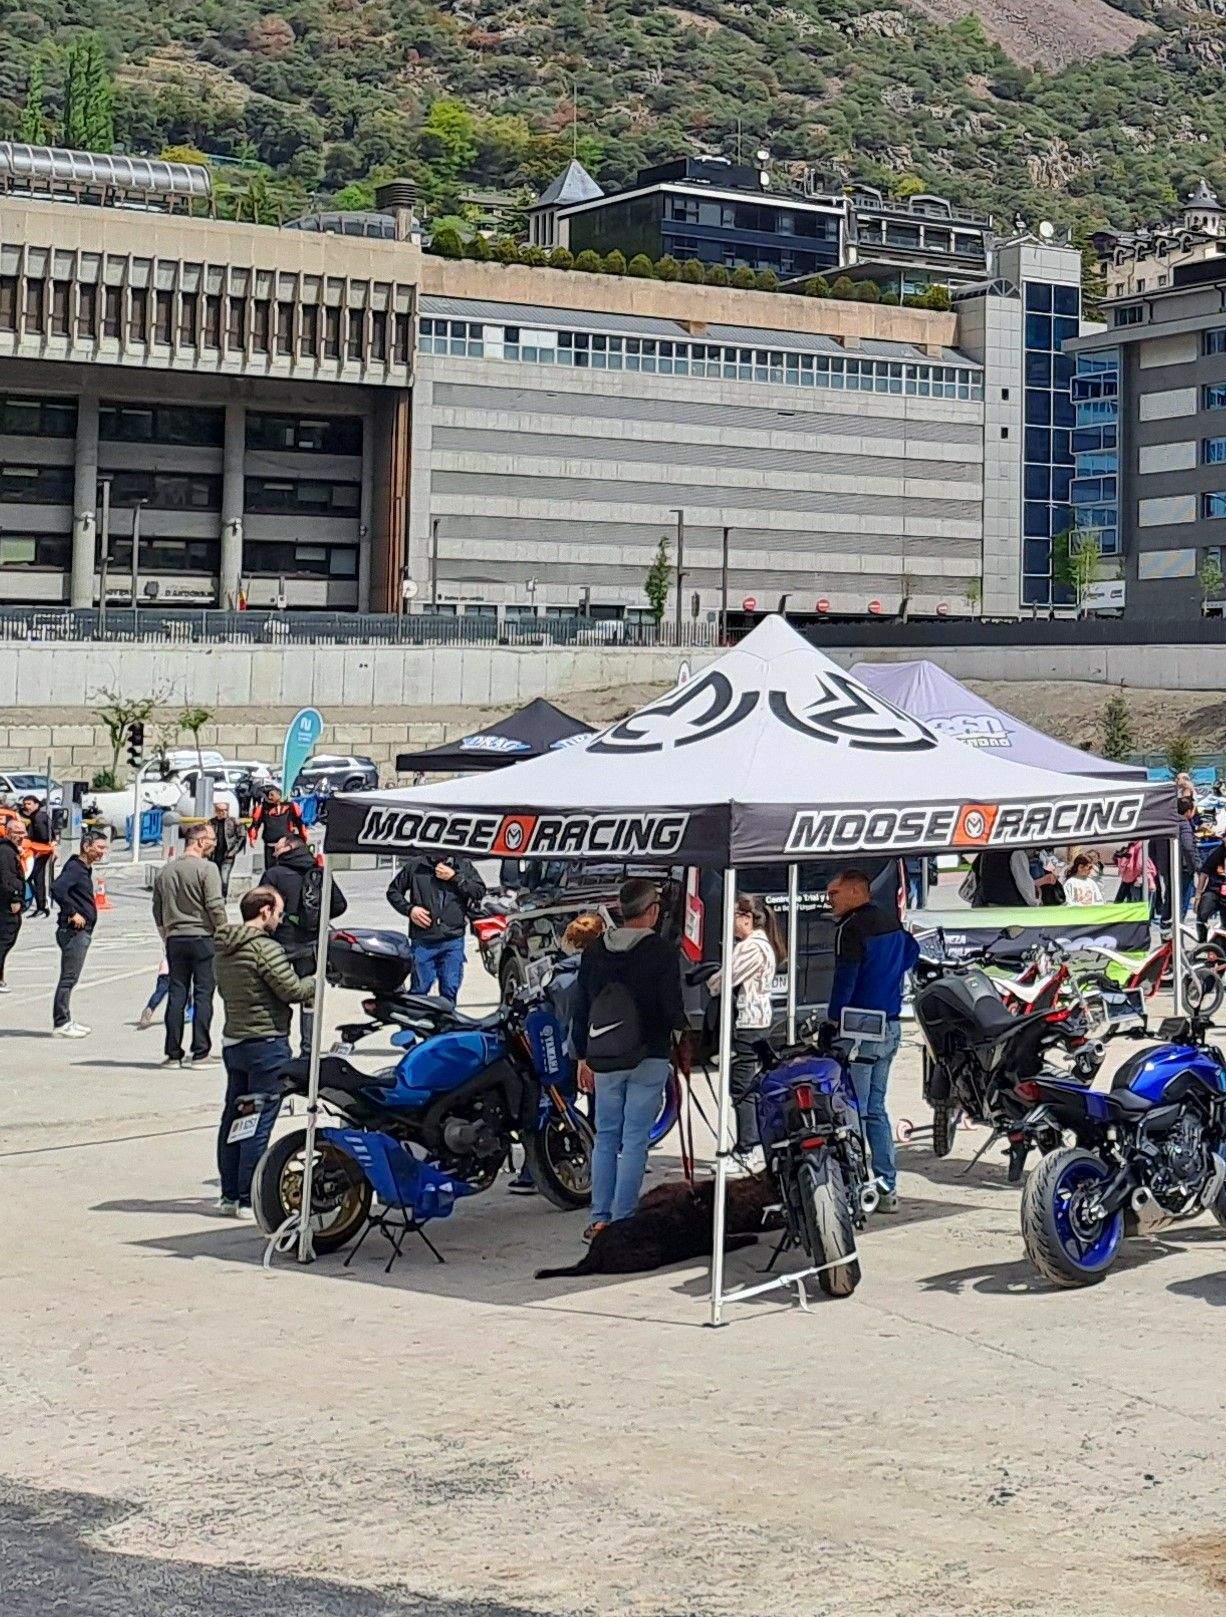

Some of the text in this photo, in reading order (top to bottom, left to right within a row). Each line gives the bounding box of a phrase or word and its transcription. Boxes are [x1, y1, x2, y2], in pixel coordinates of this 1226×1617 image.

[359, 807, 689, 853] MOOSE RACING
[786, 794, 1145, 852] MOOSE RACING
[544, 1035, 559, 1074] YAMAHA
